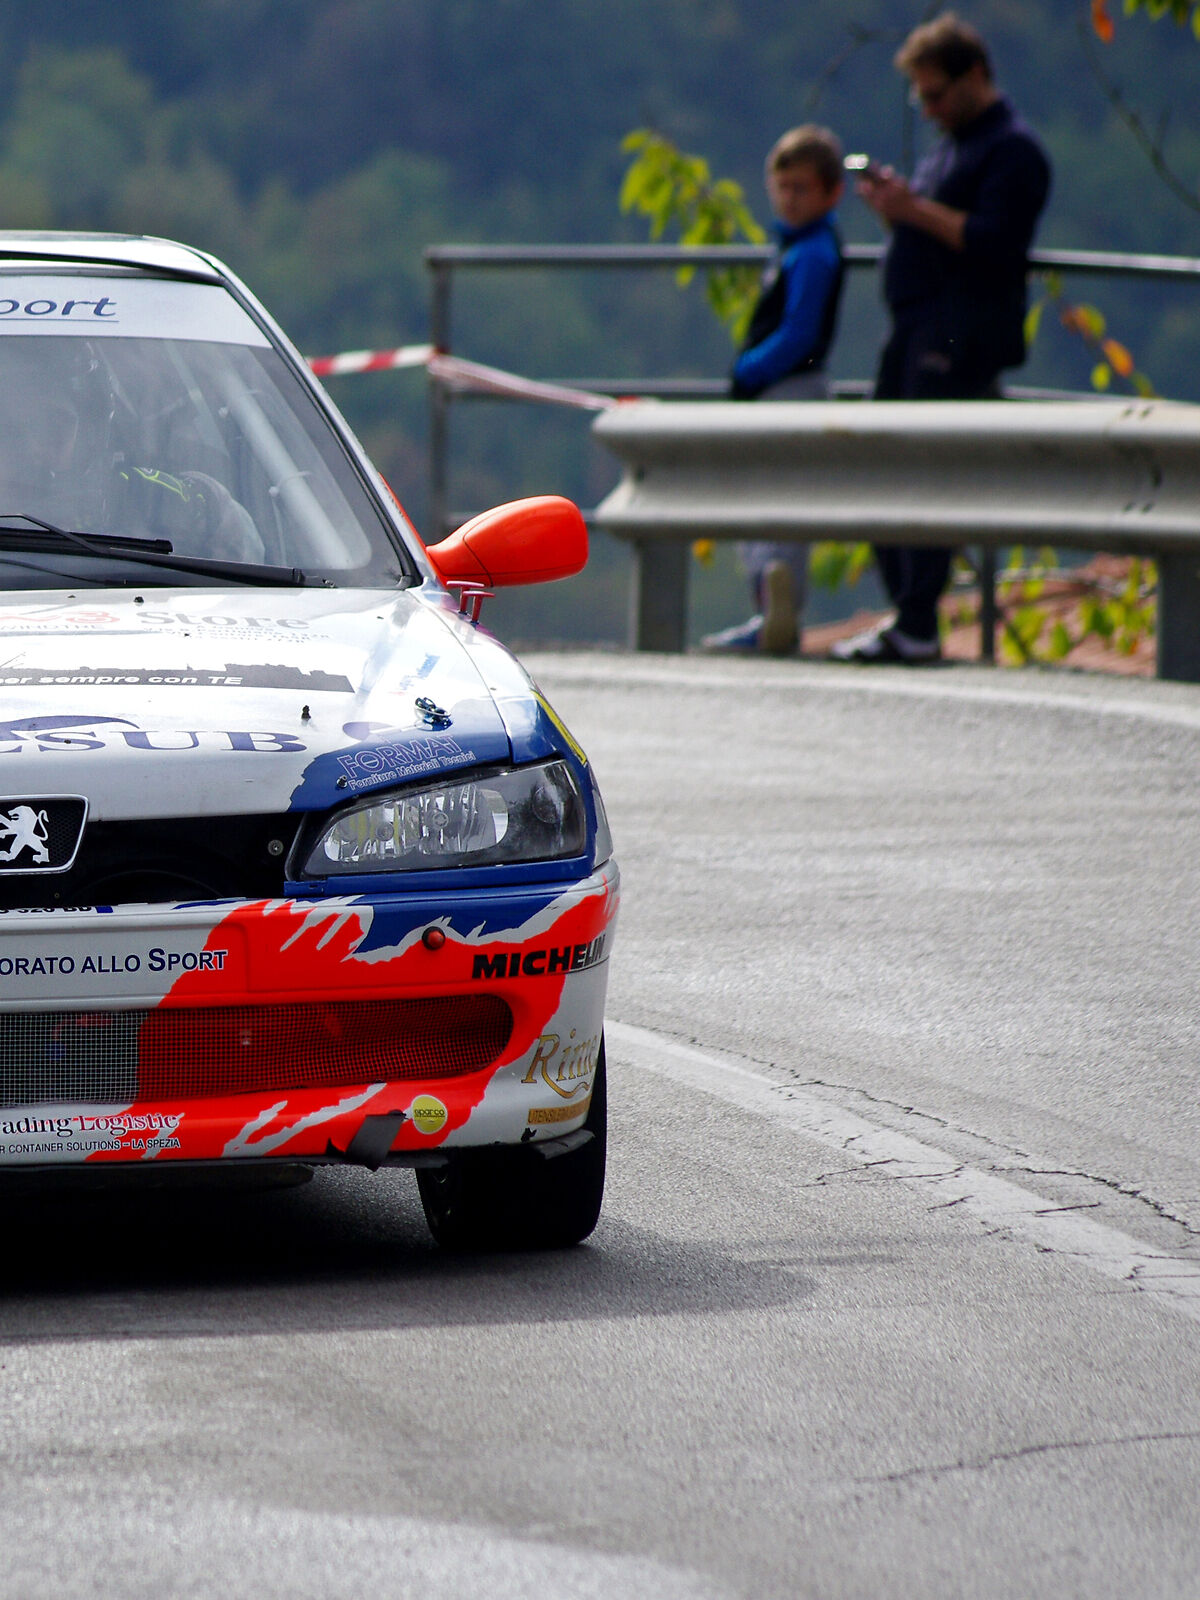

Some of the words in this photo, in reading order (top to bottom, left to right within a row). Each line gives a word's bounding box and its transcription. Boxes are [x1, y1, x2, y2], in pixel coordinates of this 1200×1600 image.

[135, 611, 311, 630] Store
[38, 676, 141, 685] sempre
[148, 676, 198, 684] con
[208, 676, 243, 685] TE
[337, 736, 462, 779] FORMAT
[348, 769, 398, 791] Forniture
[395, 757, 441, 778] Materiali
[439, 750, 477, 767] Tecnici
[472, 932, 607, 980] MICHELIN
[79, 1112, 180, 1136] Logistic
[8, 1142, 64, 1154] CONTAINER
[66, 1140, 121, 1152] SOLUTIONS
[131, 1139, 145, 1150] LA
[146, 1138, 181, 1149] SPEZIA
